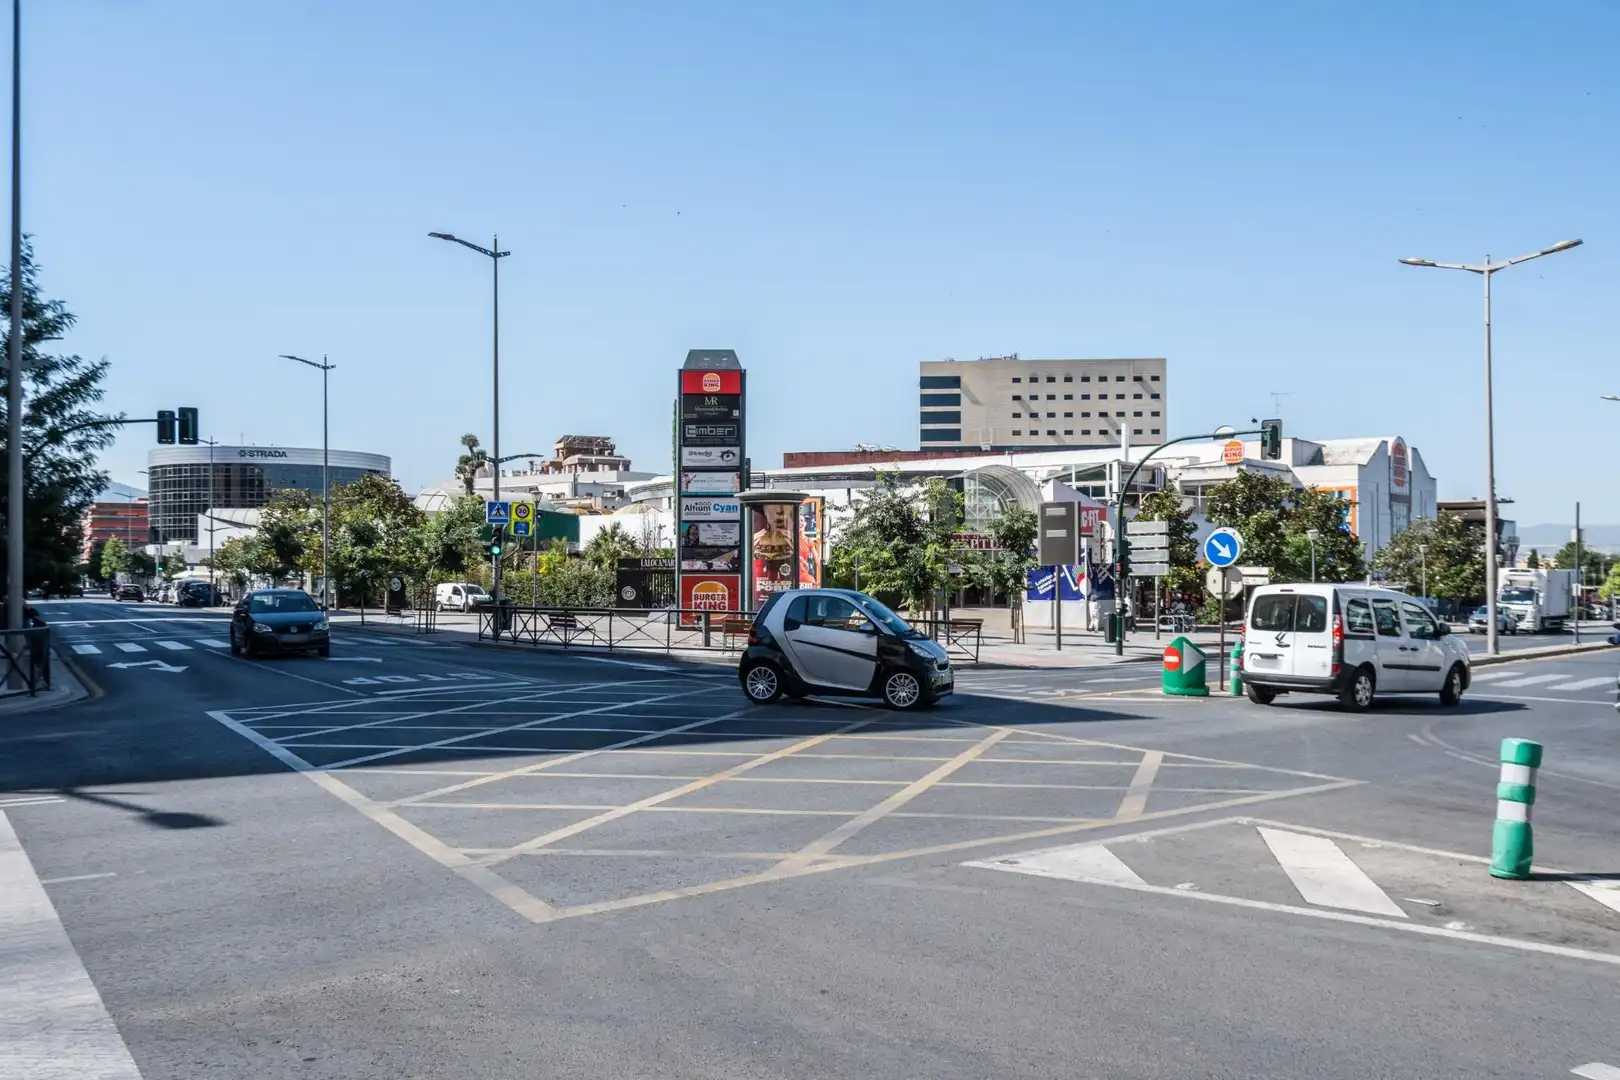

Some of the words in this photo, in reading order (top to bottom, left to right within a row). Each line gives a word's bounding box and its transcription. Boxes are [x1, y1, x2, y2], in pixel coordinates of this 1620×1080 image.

[704, 396, 718, 406] MR
[249, 450, 287, 458] STRADA
[713, 503, 738, 512] Cyan
[694, 593, 727, 601] BURGER
[694, 601, 727, 610] KING
